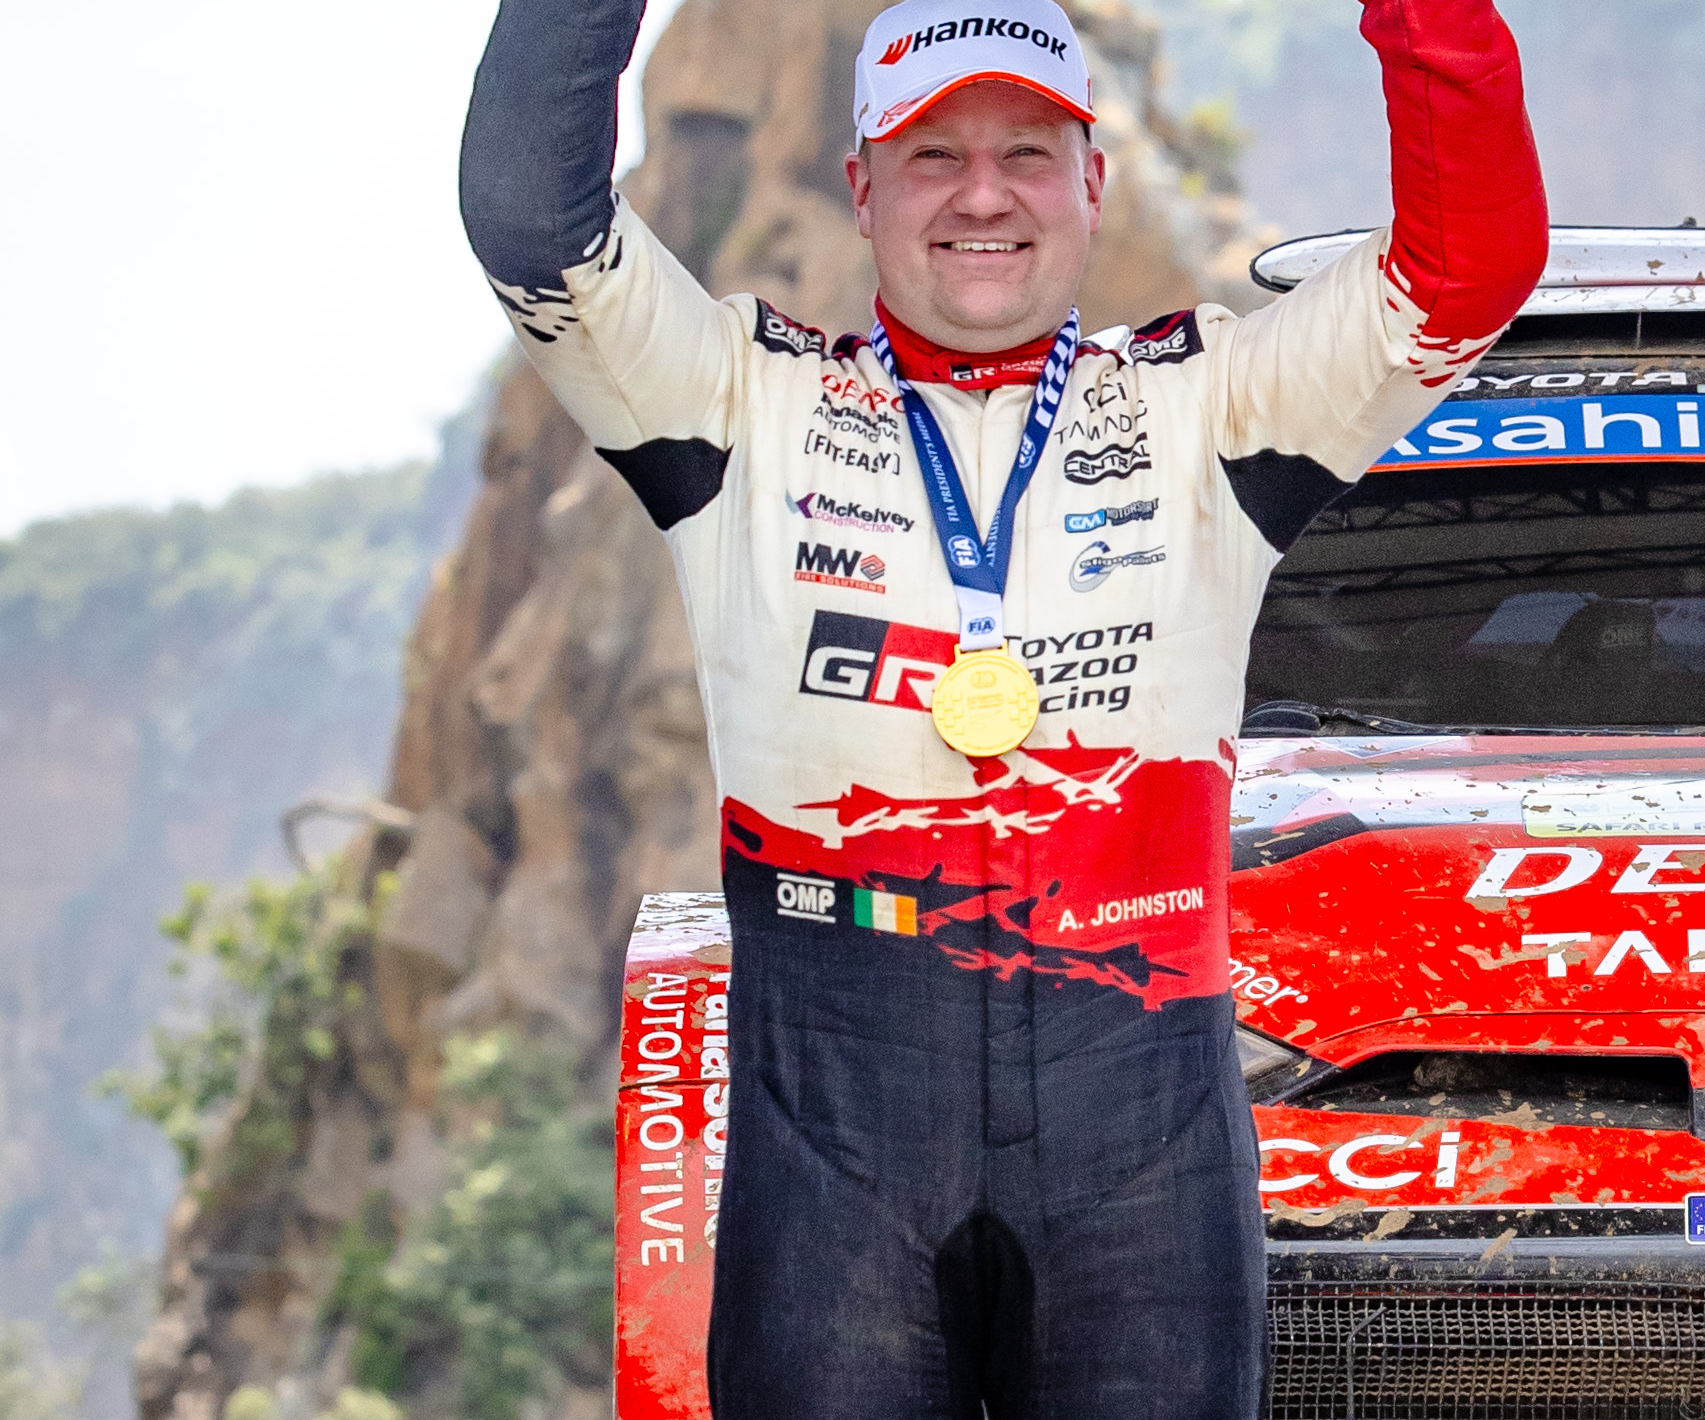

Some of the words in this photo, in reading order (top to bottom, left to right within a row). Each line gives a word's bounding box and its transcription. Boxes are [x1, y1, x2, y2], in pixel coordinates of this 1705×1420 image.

[952, 364, 998, 382] GR
[1064, 444, 1150, 475] CENTRAL
[814, 510, 895, 533] CONSTRUCTION
[817, 494, 915, 532] McKelvey
[796, 541, 862, 577] MW
[819, 576, 885, 593] SOLUTIONS
[805, 646, 948, 709] GR
[1039, 685, 1132, 714] cing
[1554, 822, 1682, 834] SAFARI
[777, 881, 836, 914] OMP
[1058, 910, 1084, 933] A.
[1091, 887, 1203, 926] JOHNSTON
[636, 972, 688, 1267] AUTOMOTIVE
